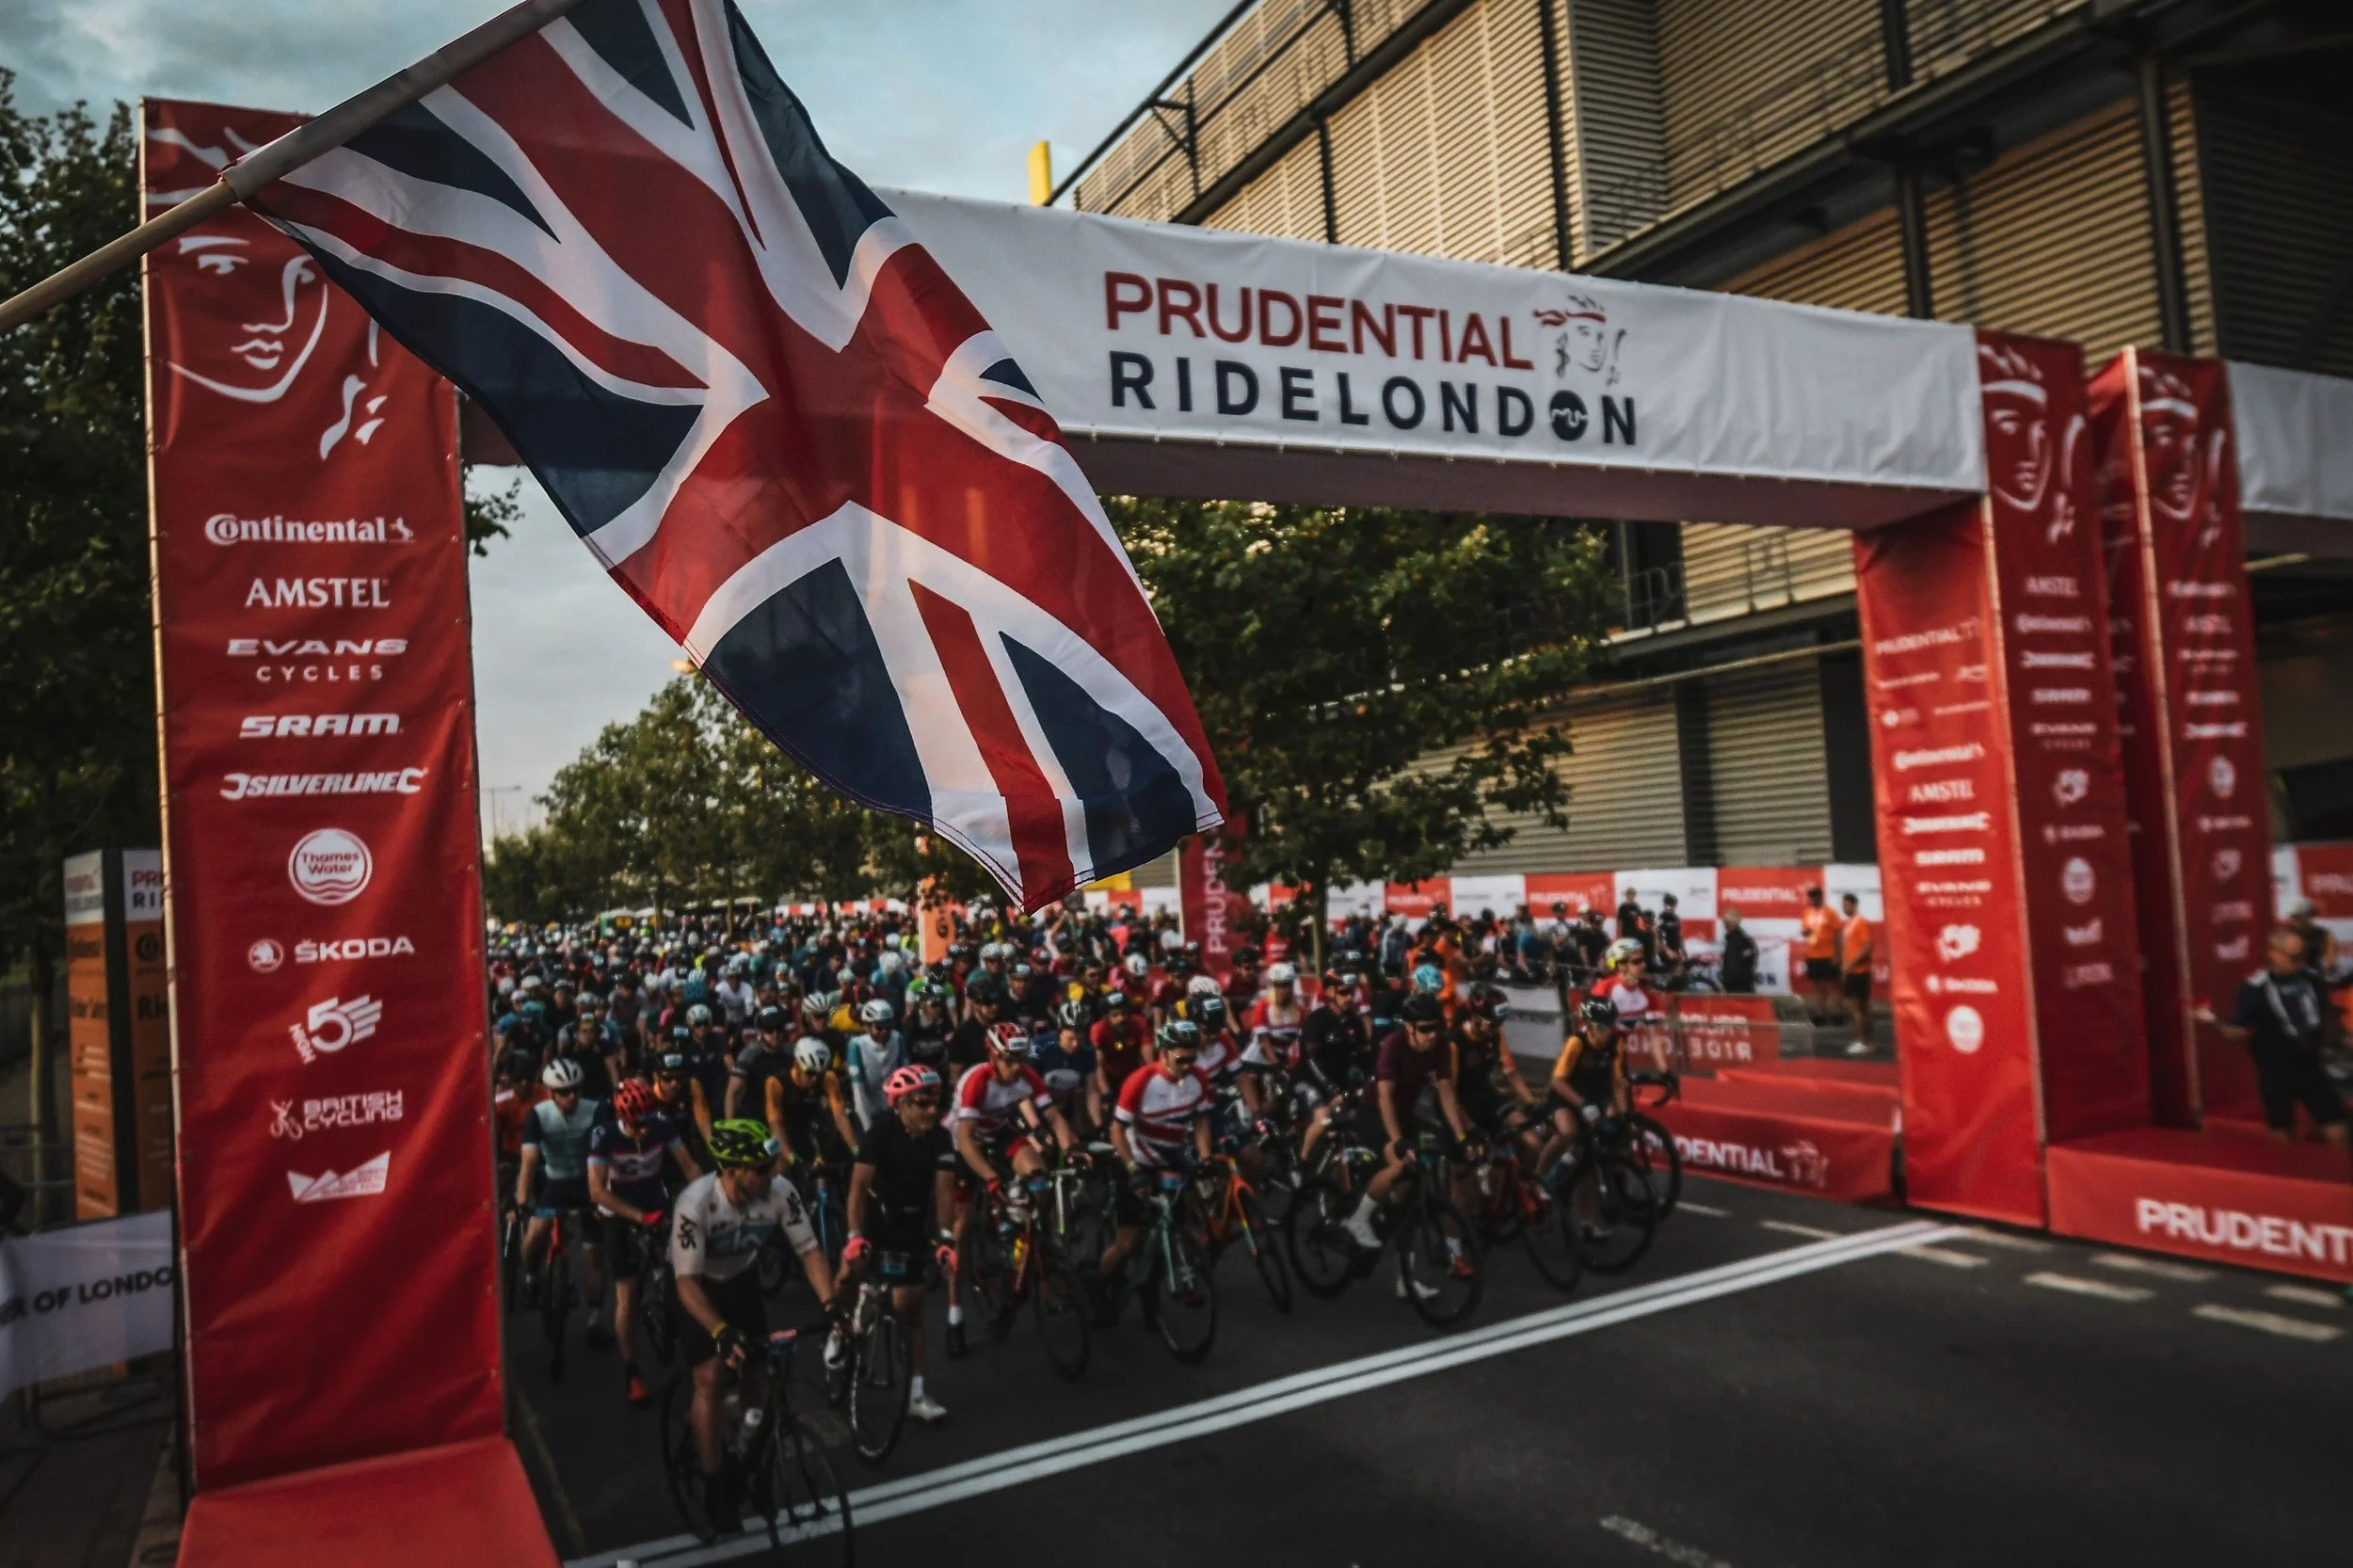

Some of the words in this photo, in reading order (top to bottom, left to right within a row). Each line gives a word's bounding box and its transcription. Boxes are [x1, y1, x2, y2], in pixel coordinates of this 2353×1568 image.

[1104, 271, 1535, 371] PRUDENTIAL
[1109, 350, 1637, 445] RIDELONDON
[205, 513, 387, 546] Continental
[245, 577, 391, 608] AMSTEL
[227, 638, 408, 656] EVANS
[256, 664, 383, 681] CYCLES
[239, 712, 401, 740] SRAM
[244, 770, 403, 798] SILVERLINE
[302, 852, 360, 864] Thames
[308, 863, 353, 875] Water
[295, 936, 414, 963] ŠKODA
[304, 1090, 402, 1114] BRITISH
[303, 1104, 403, 1130] CYCLING
[2136, 1197, 2353, 1263] PRUDENT
[34, 1287, 71, 1314] OF
[78, 1266, 173, 1304] LONDO
